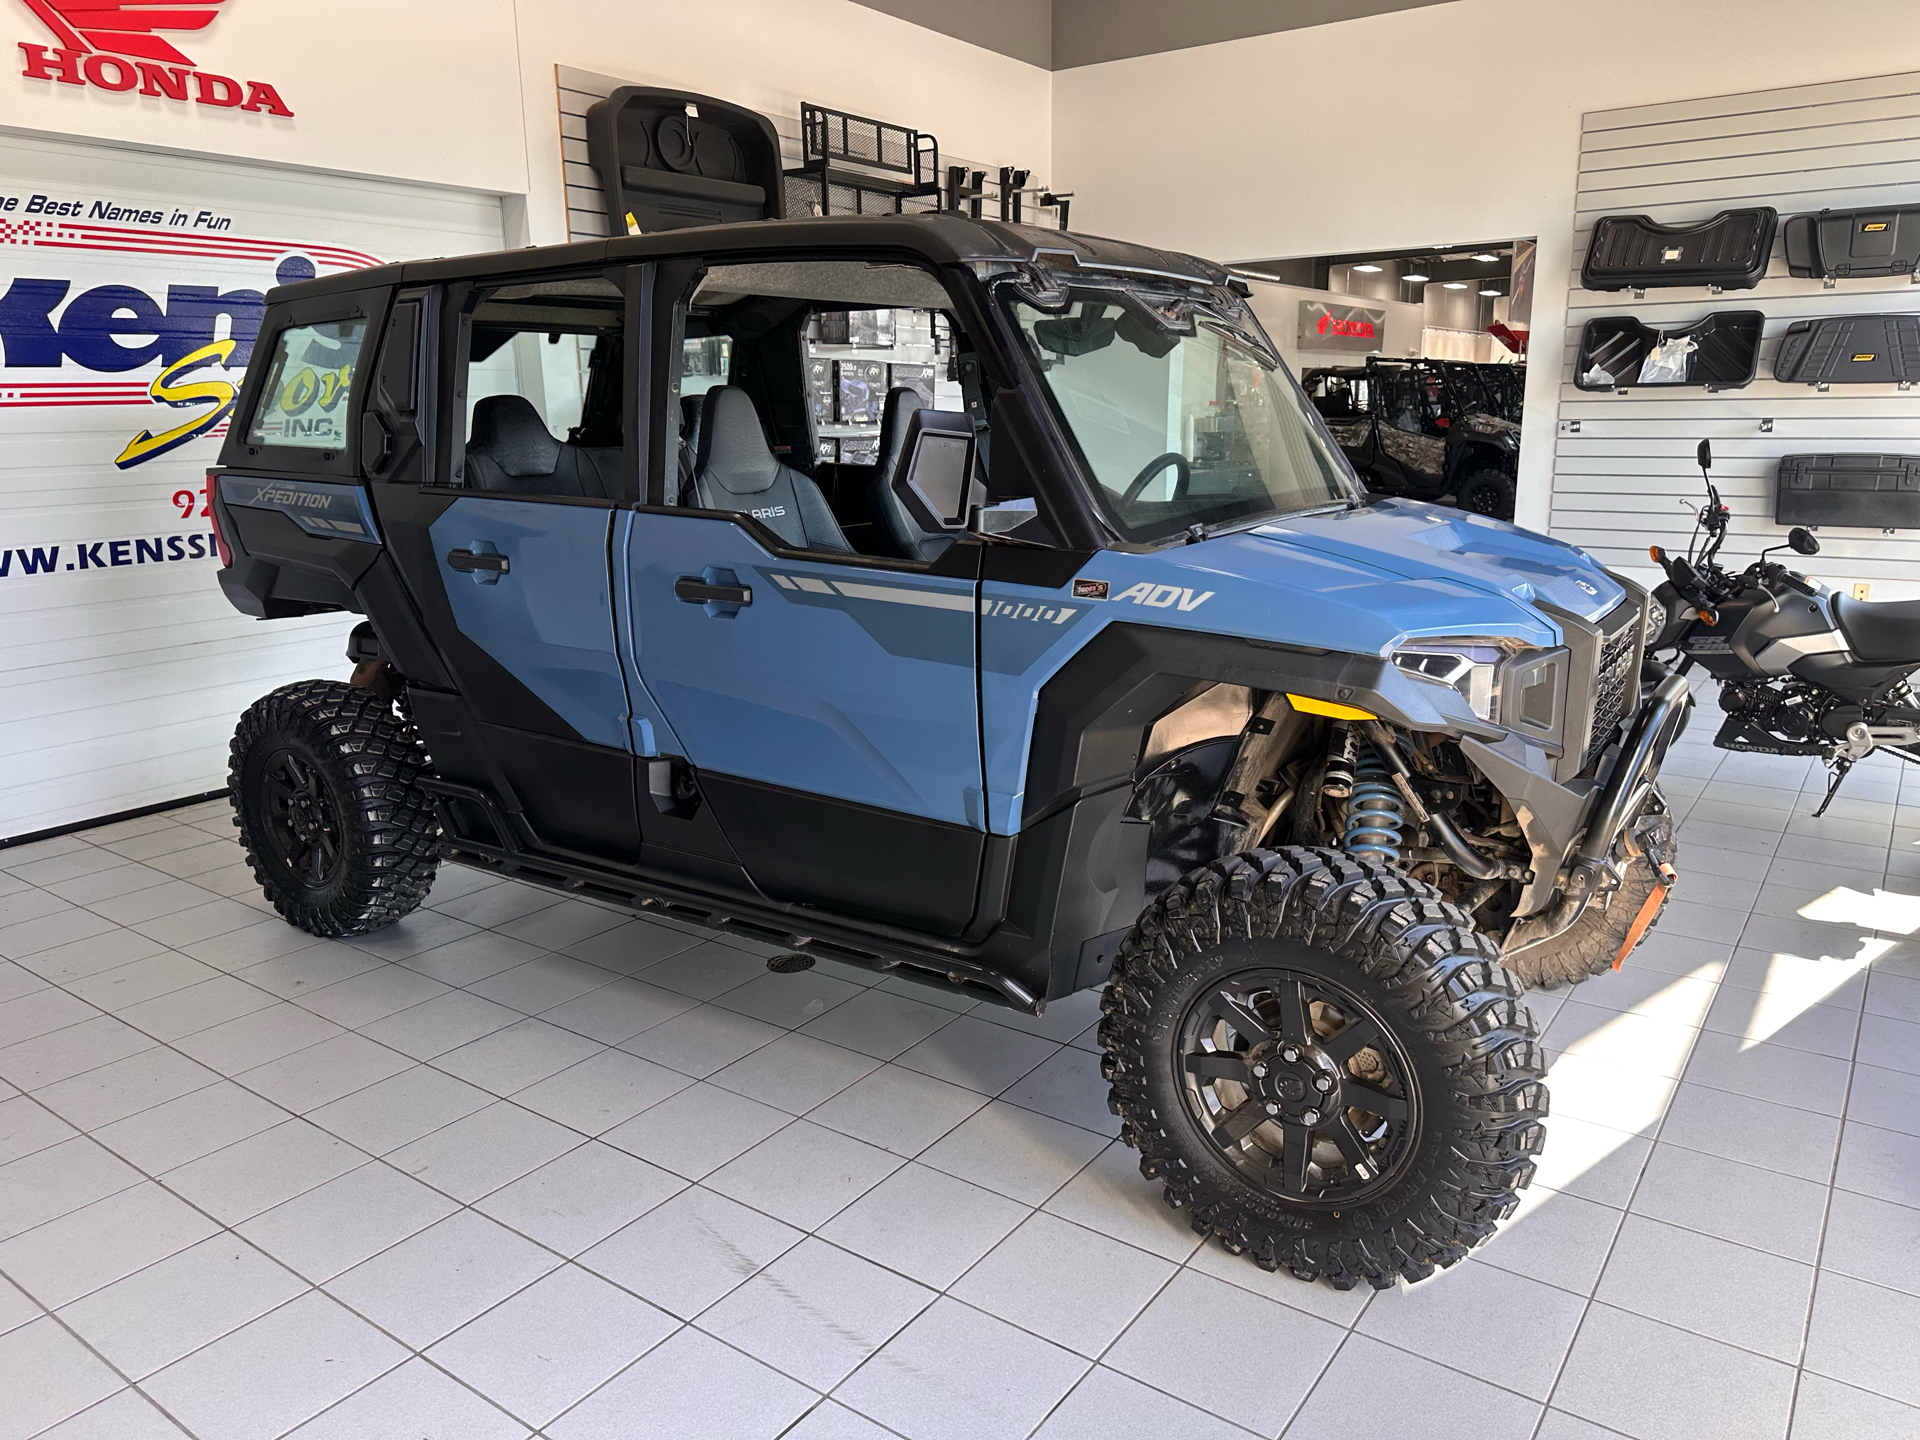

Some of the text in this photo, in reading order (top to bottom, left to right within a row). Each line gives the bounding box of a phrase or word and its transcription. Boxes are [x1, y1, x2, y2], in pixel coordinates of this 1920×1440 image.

[18, 42, 295, 117] HONDA
[25, 194, 84, 217] Best
[88, 201, 164, 225] Names
[169, 209, 188, 227] in
[193, 211, 232, 231] Fun
[1331, 318, 1375, 338] HONDA
[248, 482, 333, 509] XPEDITION
[1110, 582, 1216, 612] ADV
[1724, 742, 1779, 754] HONDA
